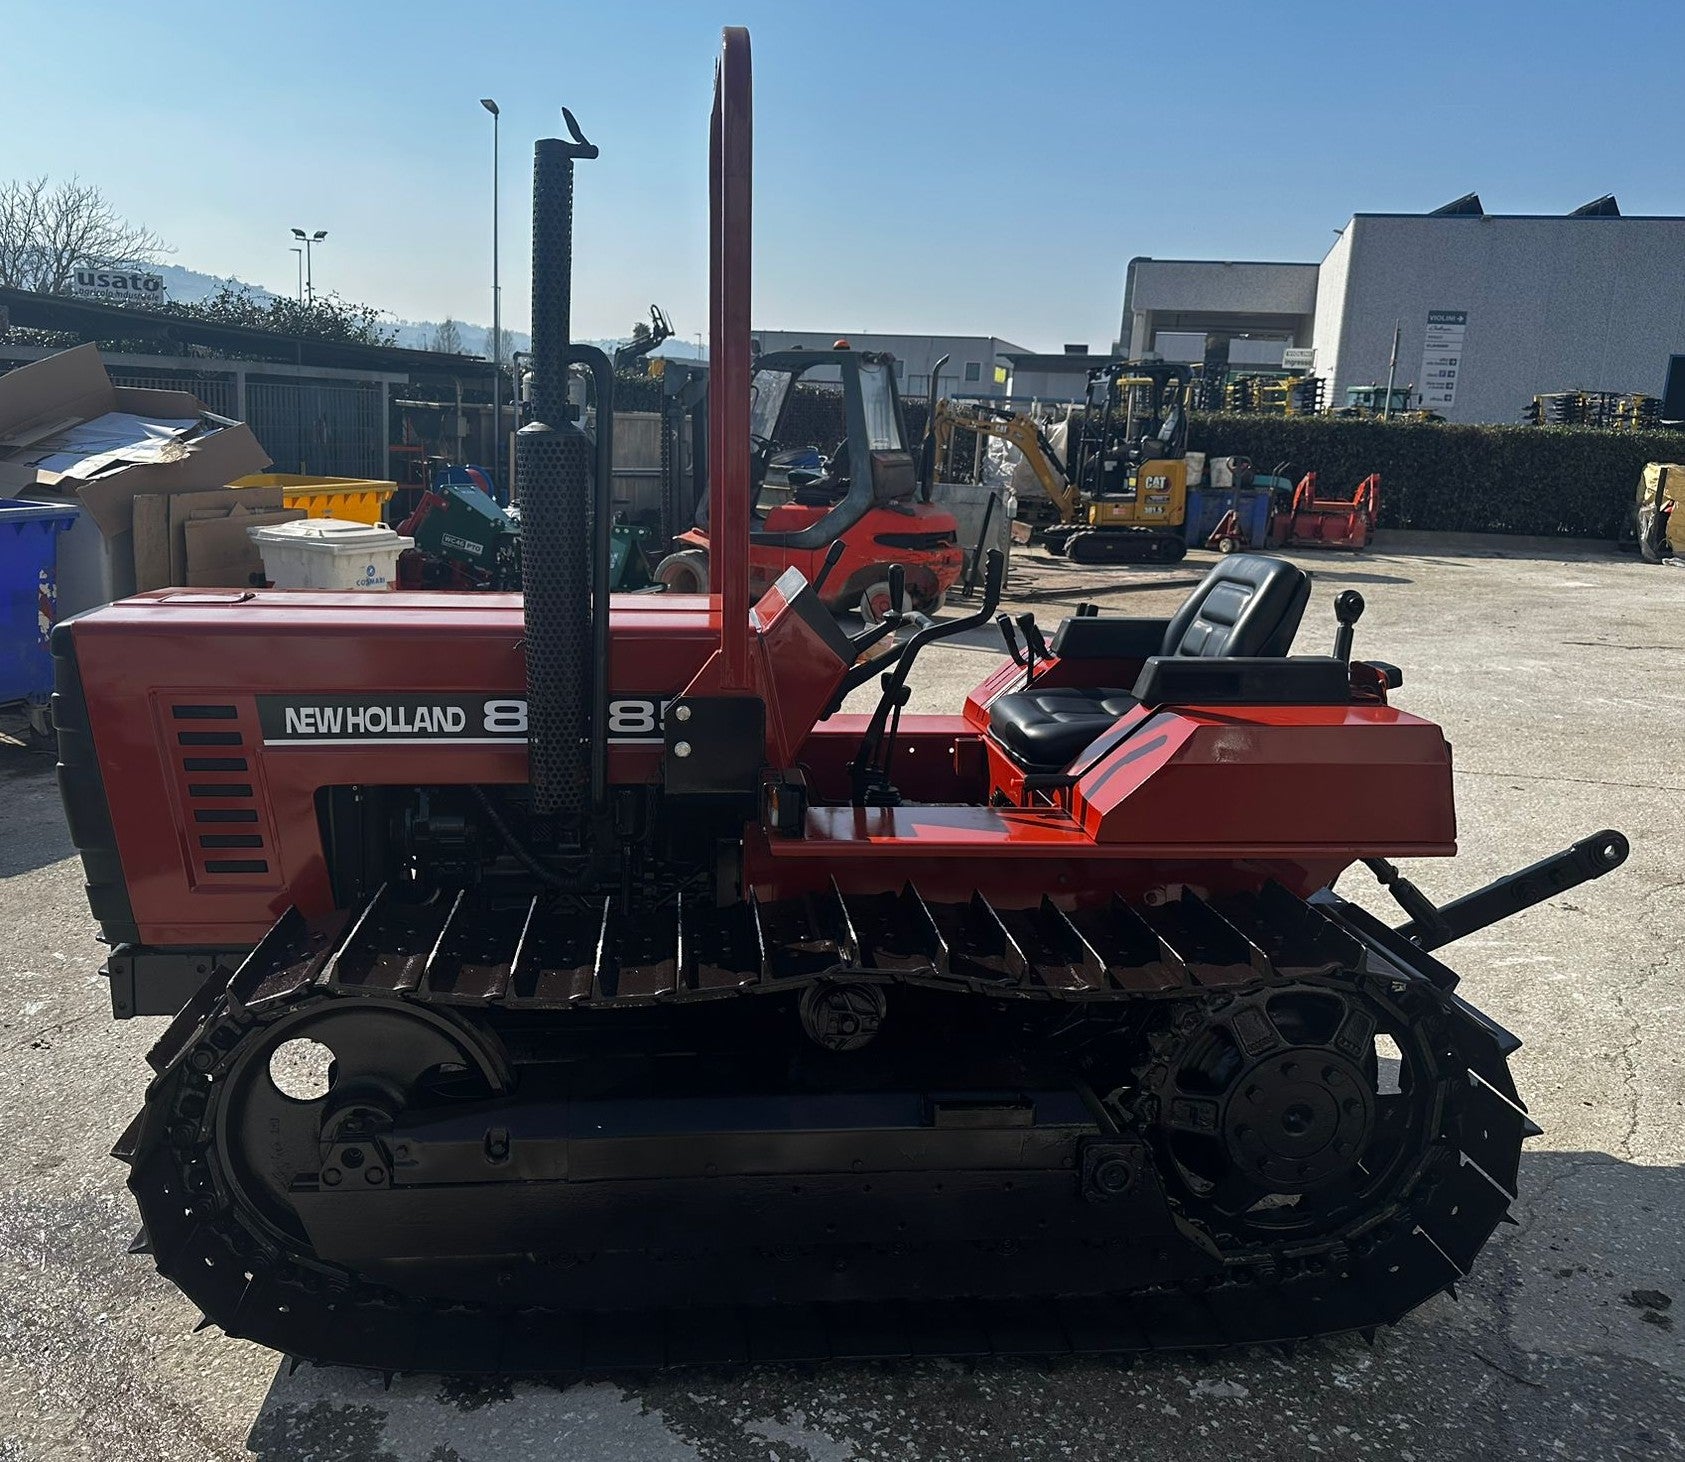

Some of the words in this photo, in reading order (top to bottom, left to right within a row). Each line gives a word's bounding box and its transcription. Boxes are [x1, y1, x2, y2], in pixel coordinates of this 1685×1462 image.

[78, 272, 160, 291] usato
[1145, 476, 1166, 489] CAT
[466, 542, 482, 552] PTO
[285, 706, 343, 734] NEW
[346, 706, 466, 733] HOLLAND
